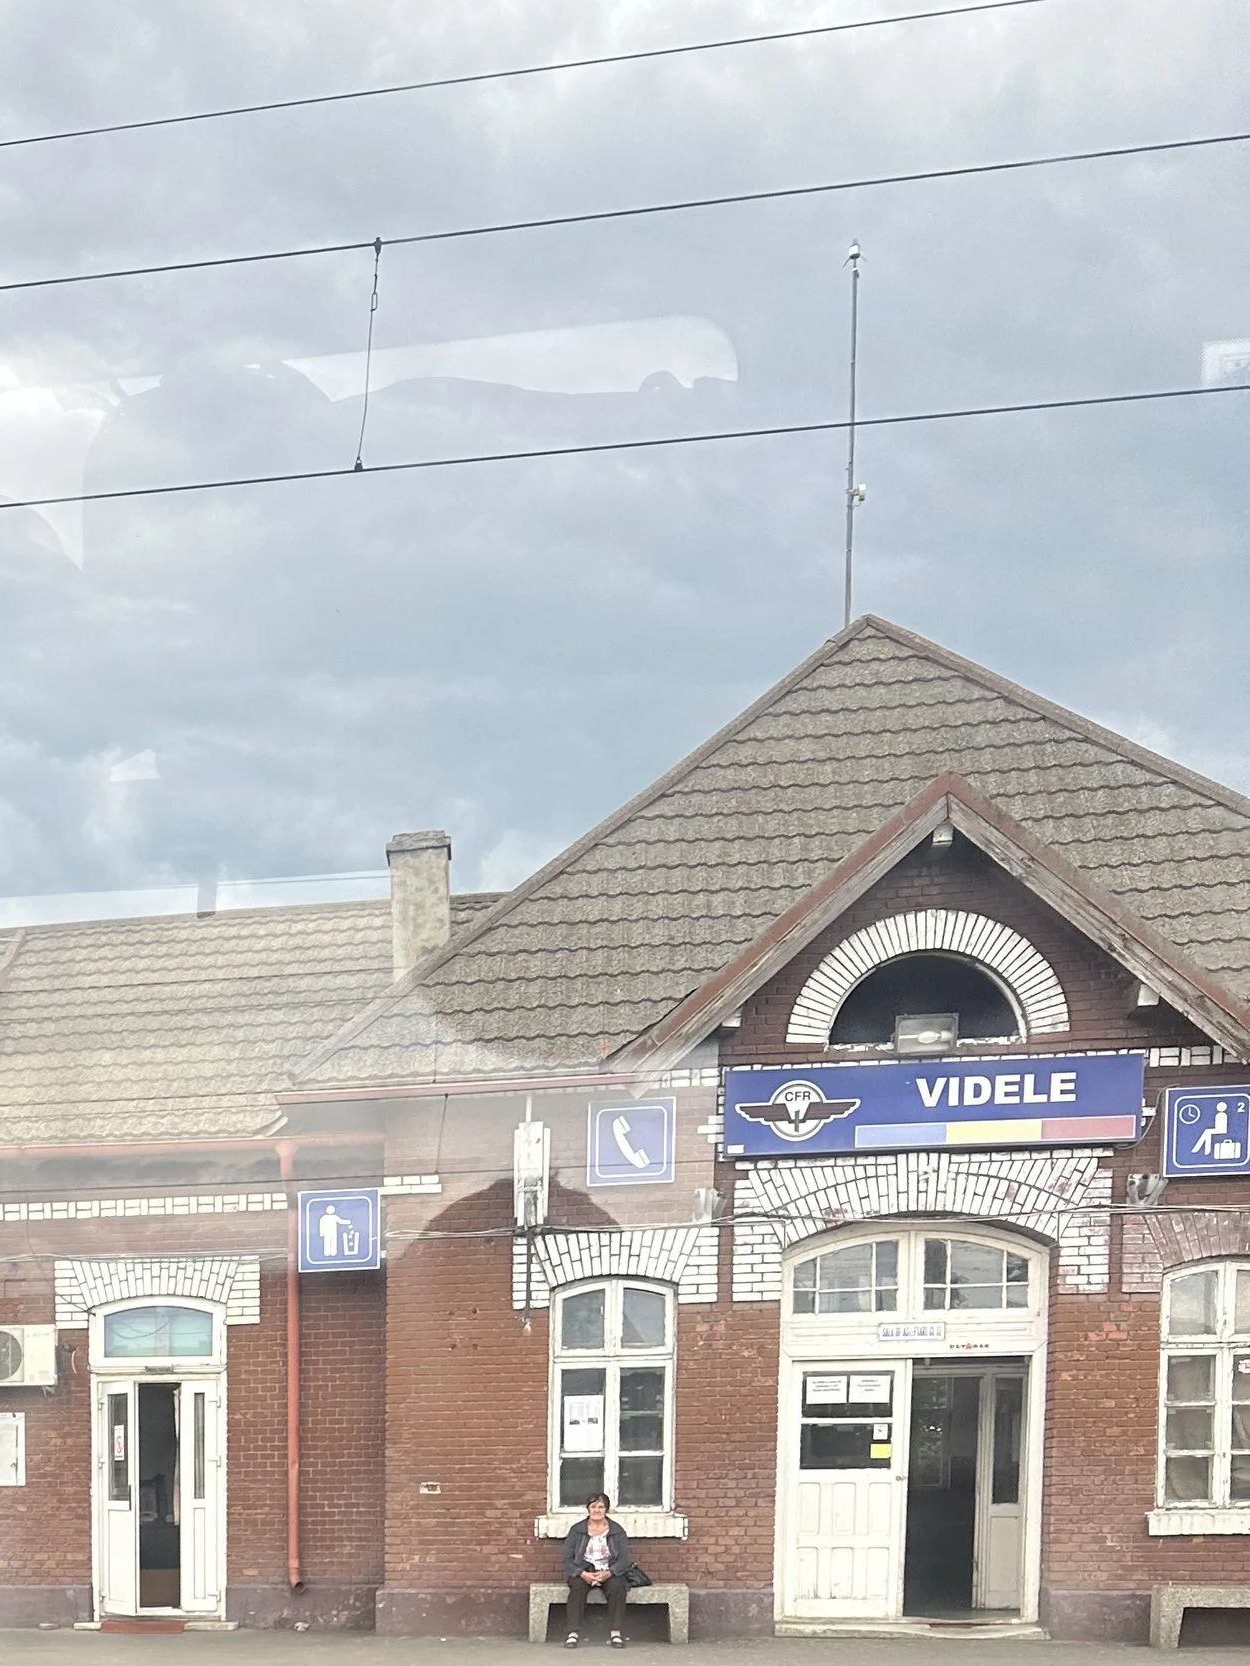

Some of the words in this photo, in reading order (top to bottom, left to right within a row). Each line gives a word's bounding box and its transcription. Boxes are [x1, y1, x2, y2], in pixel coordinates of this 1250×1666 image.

[915, 1071, 1077, 1108] VIDELE
[784, 1091, 811, 1103] CFR
[1237, 1102, 1245, 1112] 2
